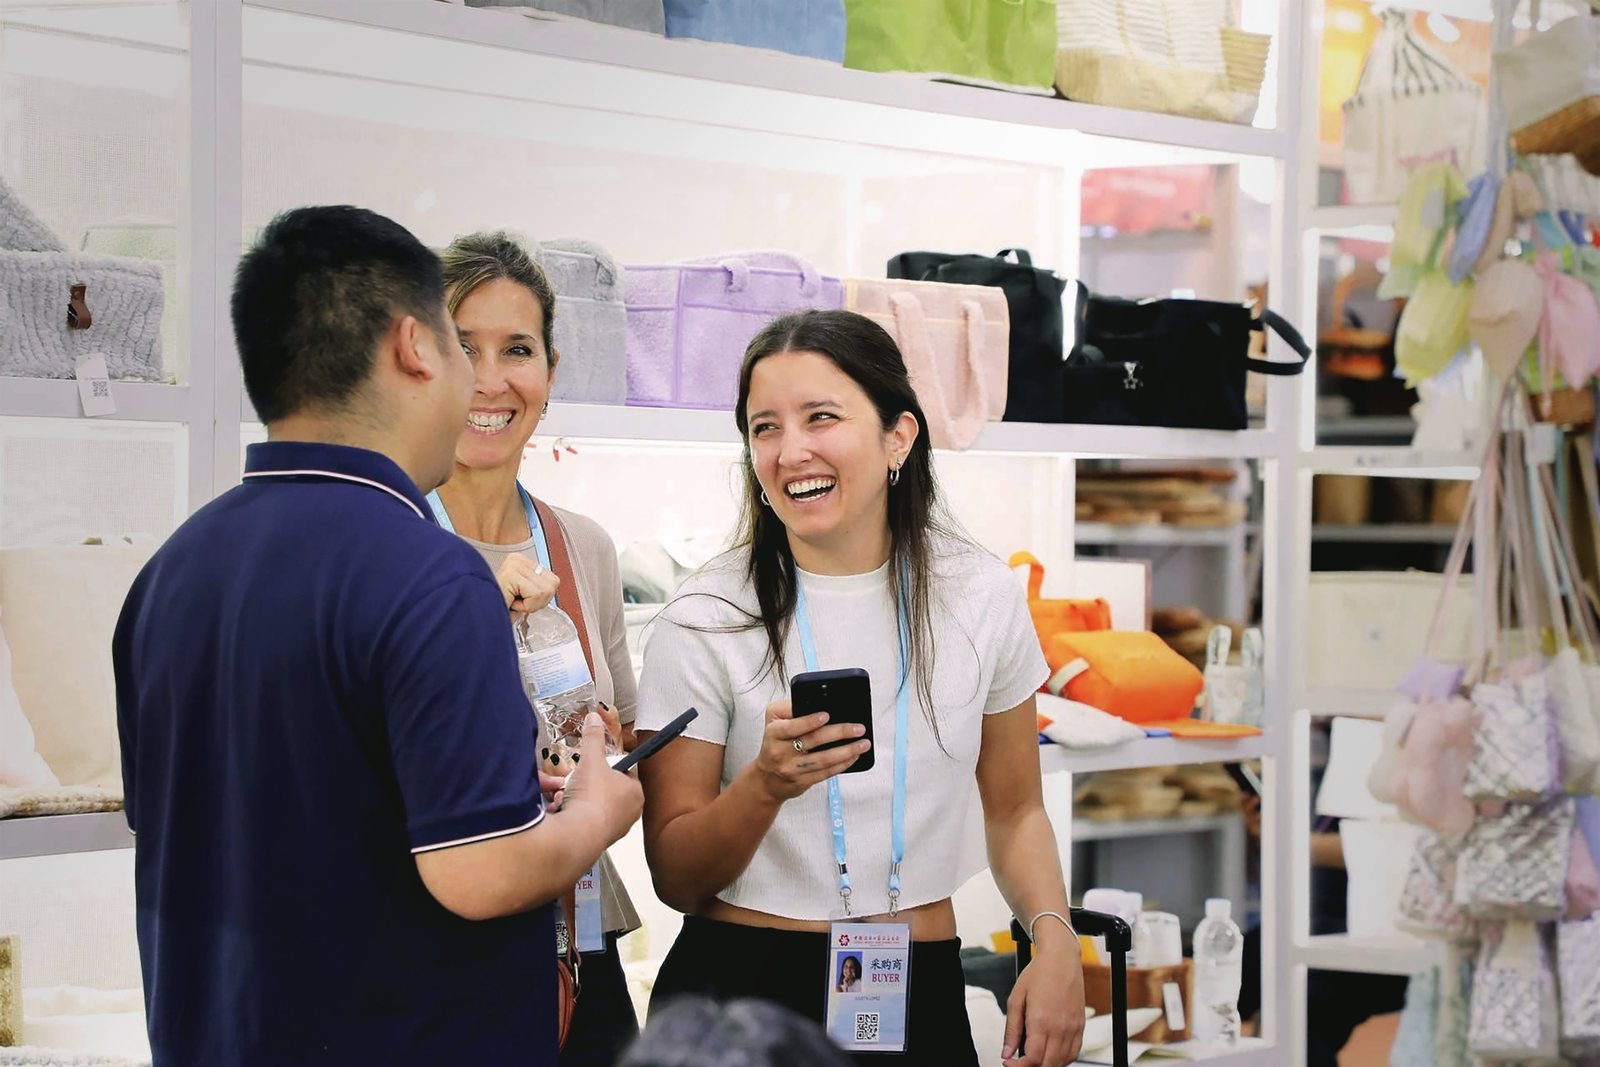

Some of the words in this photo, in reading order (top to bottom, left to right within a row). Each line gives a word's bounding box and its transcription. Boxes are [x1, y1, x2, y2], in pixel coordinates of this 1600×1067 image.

[576, 880, 593, 890] YER
[870, 958, 902, 971] 采购商
[872, 973, 900, 983] BUYER
